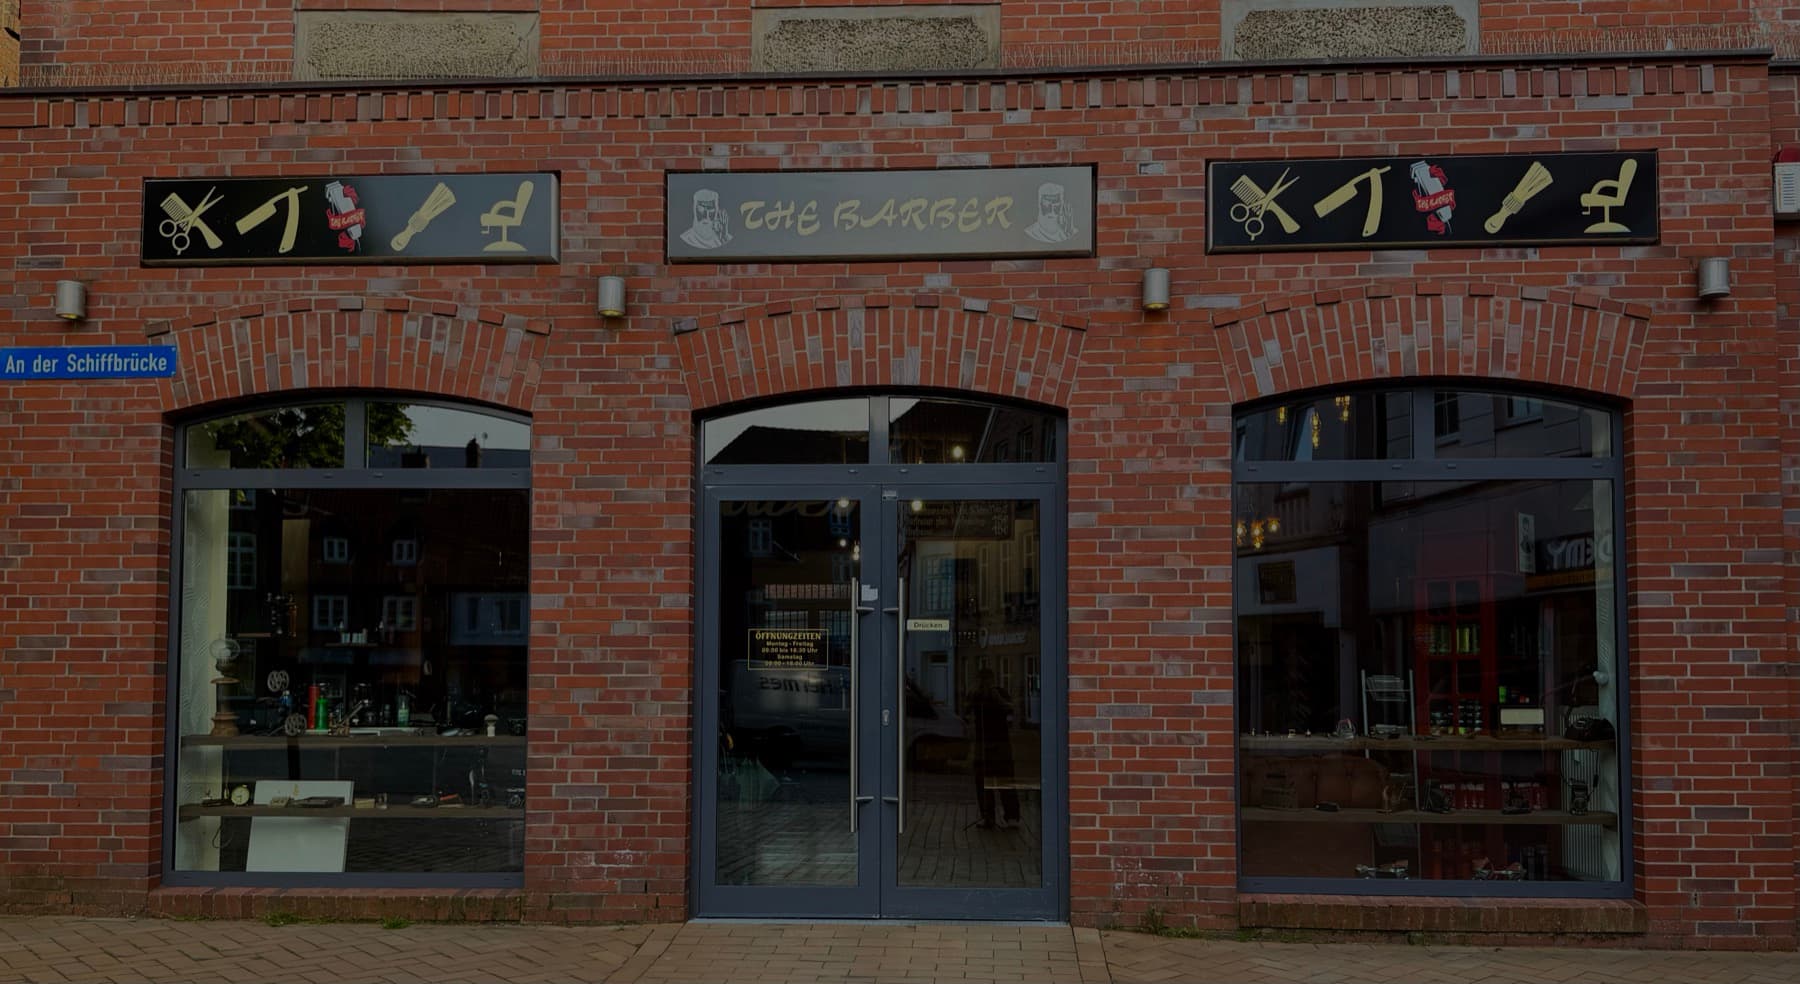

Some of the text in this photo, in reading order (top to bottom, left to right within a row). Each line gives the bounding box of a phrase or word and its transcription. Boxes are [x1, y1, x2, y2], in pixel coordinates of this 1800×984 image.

[739, 196, 1013, 236] THE BARBER
[5, 352, 168, 374] An der Schiffbrücke
